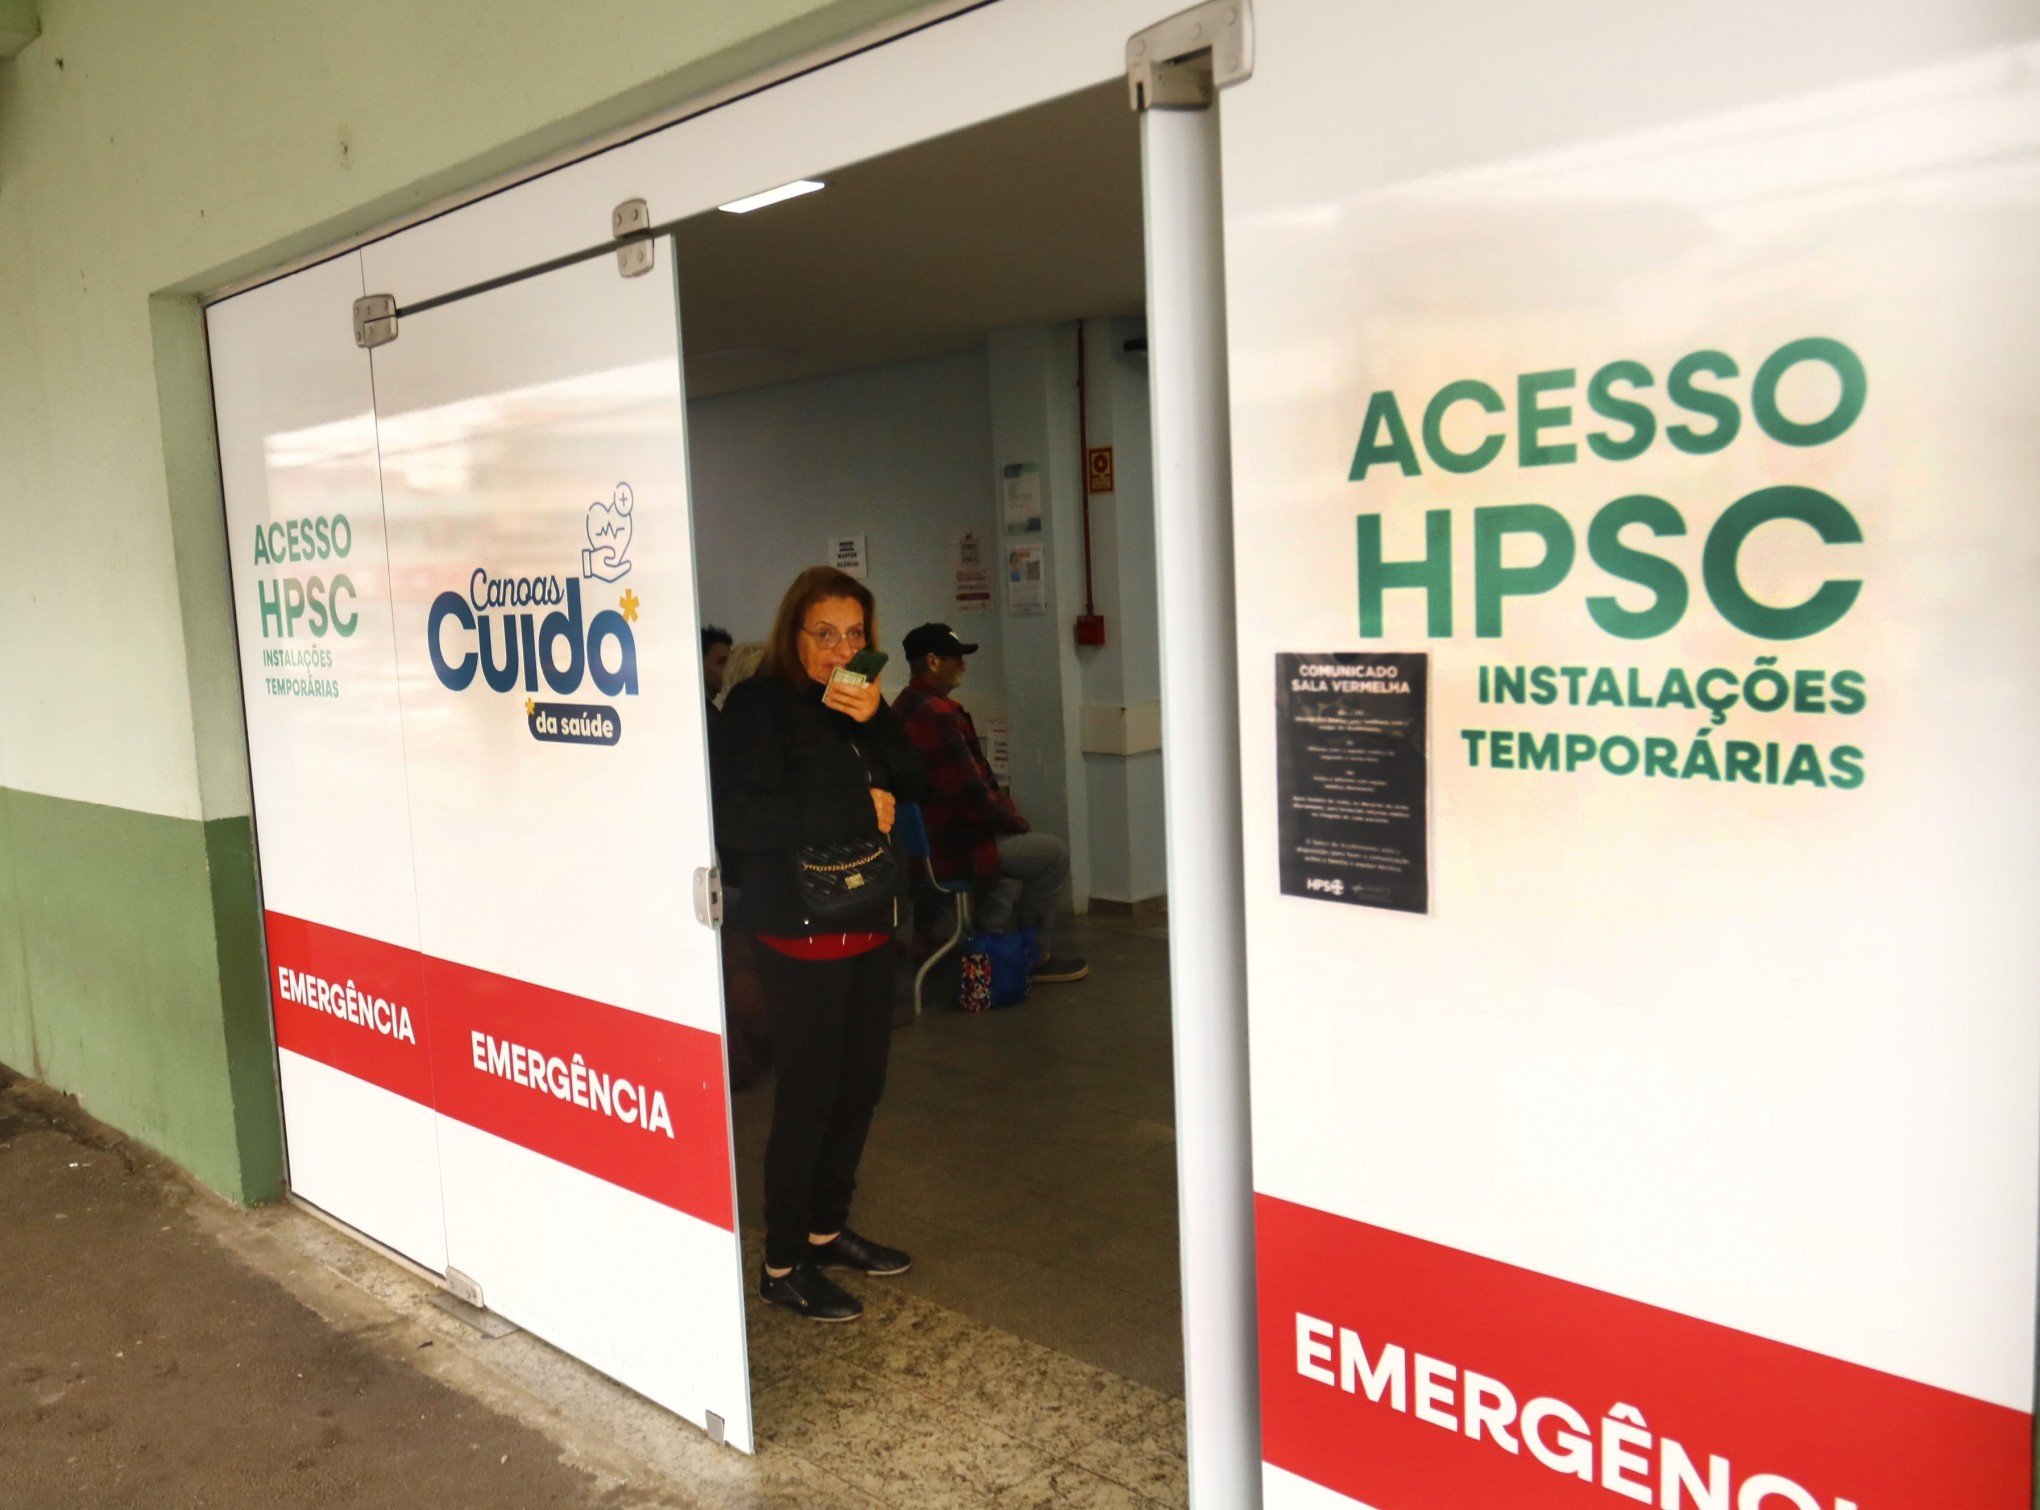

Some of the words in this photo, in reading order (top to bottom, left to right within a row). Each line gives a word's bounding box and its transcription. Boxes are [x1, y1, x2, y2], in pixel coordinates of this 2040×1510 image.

[1348, 337, 1868, 482] ACESSO
[254, 514, 351, 565] ACESSO
[1356, 485, 1864, 641] HPSC
[258, 573, 358, 638] HPSC
[470, 567, 565, 612] Canoas
[262, 644, 333, 674] INSTALAÇÕES
[428, 577, 639, 697] Cuida
[265, 674, 340, 699] TEMPORÁRIAS
[1291, 679, 1328, 692] SALA
[1331, 680, 1411, 694] VERMELHA
[1299, 664, 1398, 679] COMUNICADO
[1478, 656, 1868, 725] INSTALAÇÕES
[536, 711, 557, 734] da
[561, 712, 614, 738] saúde
[1460, 727, 1867, 790] TEMPORÁRIAS
[278, 965, 416, 1046] EMERGÊNCIA
[471, 1029, 675, 1139] EMERGÊNCIA
[1295, 1310, 1858, 1510] EMERGÊN
